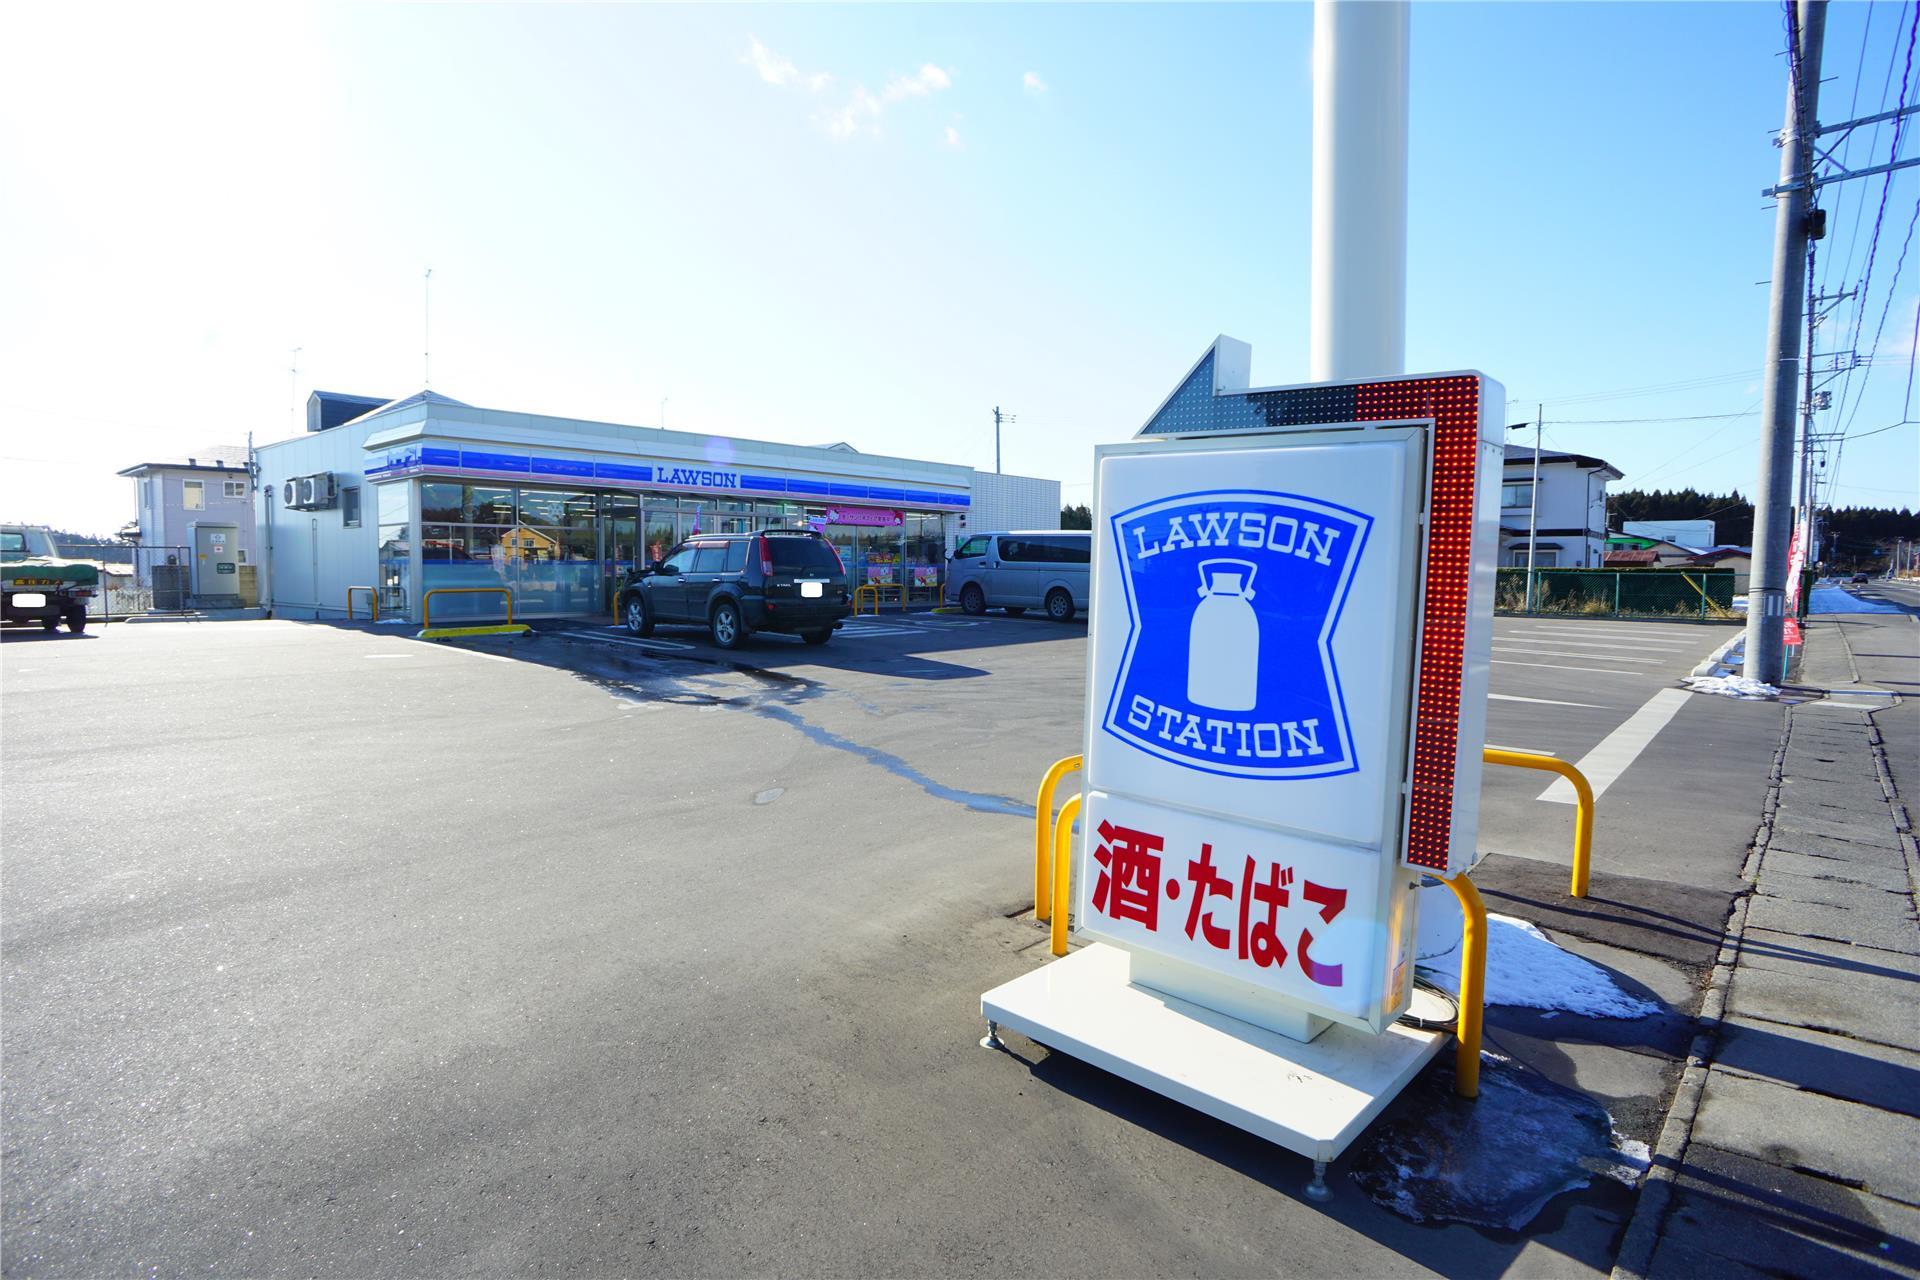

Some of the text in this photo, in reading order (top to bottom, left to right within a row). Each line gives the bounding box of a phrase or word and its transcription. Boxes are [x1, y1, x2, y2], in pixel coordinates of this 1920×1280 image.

[657, 467, 737, 488] LAWSON
[1132, 511, 1340, 567] LAWSON
[1127, 693, 1325, 758] STATION
[1091, 819, 1347, 987] 酒・たばこ
